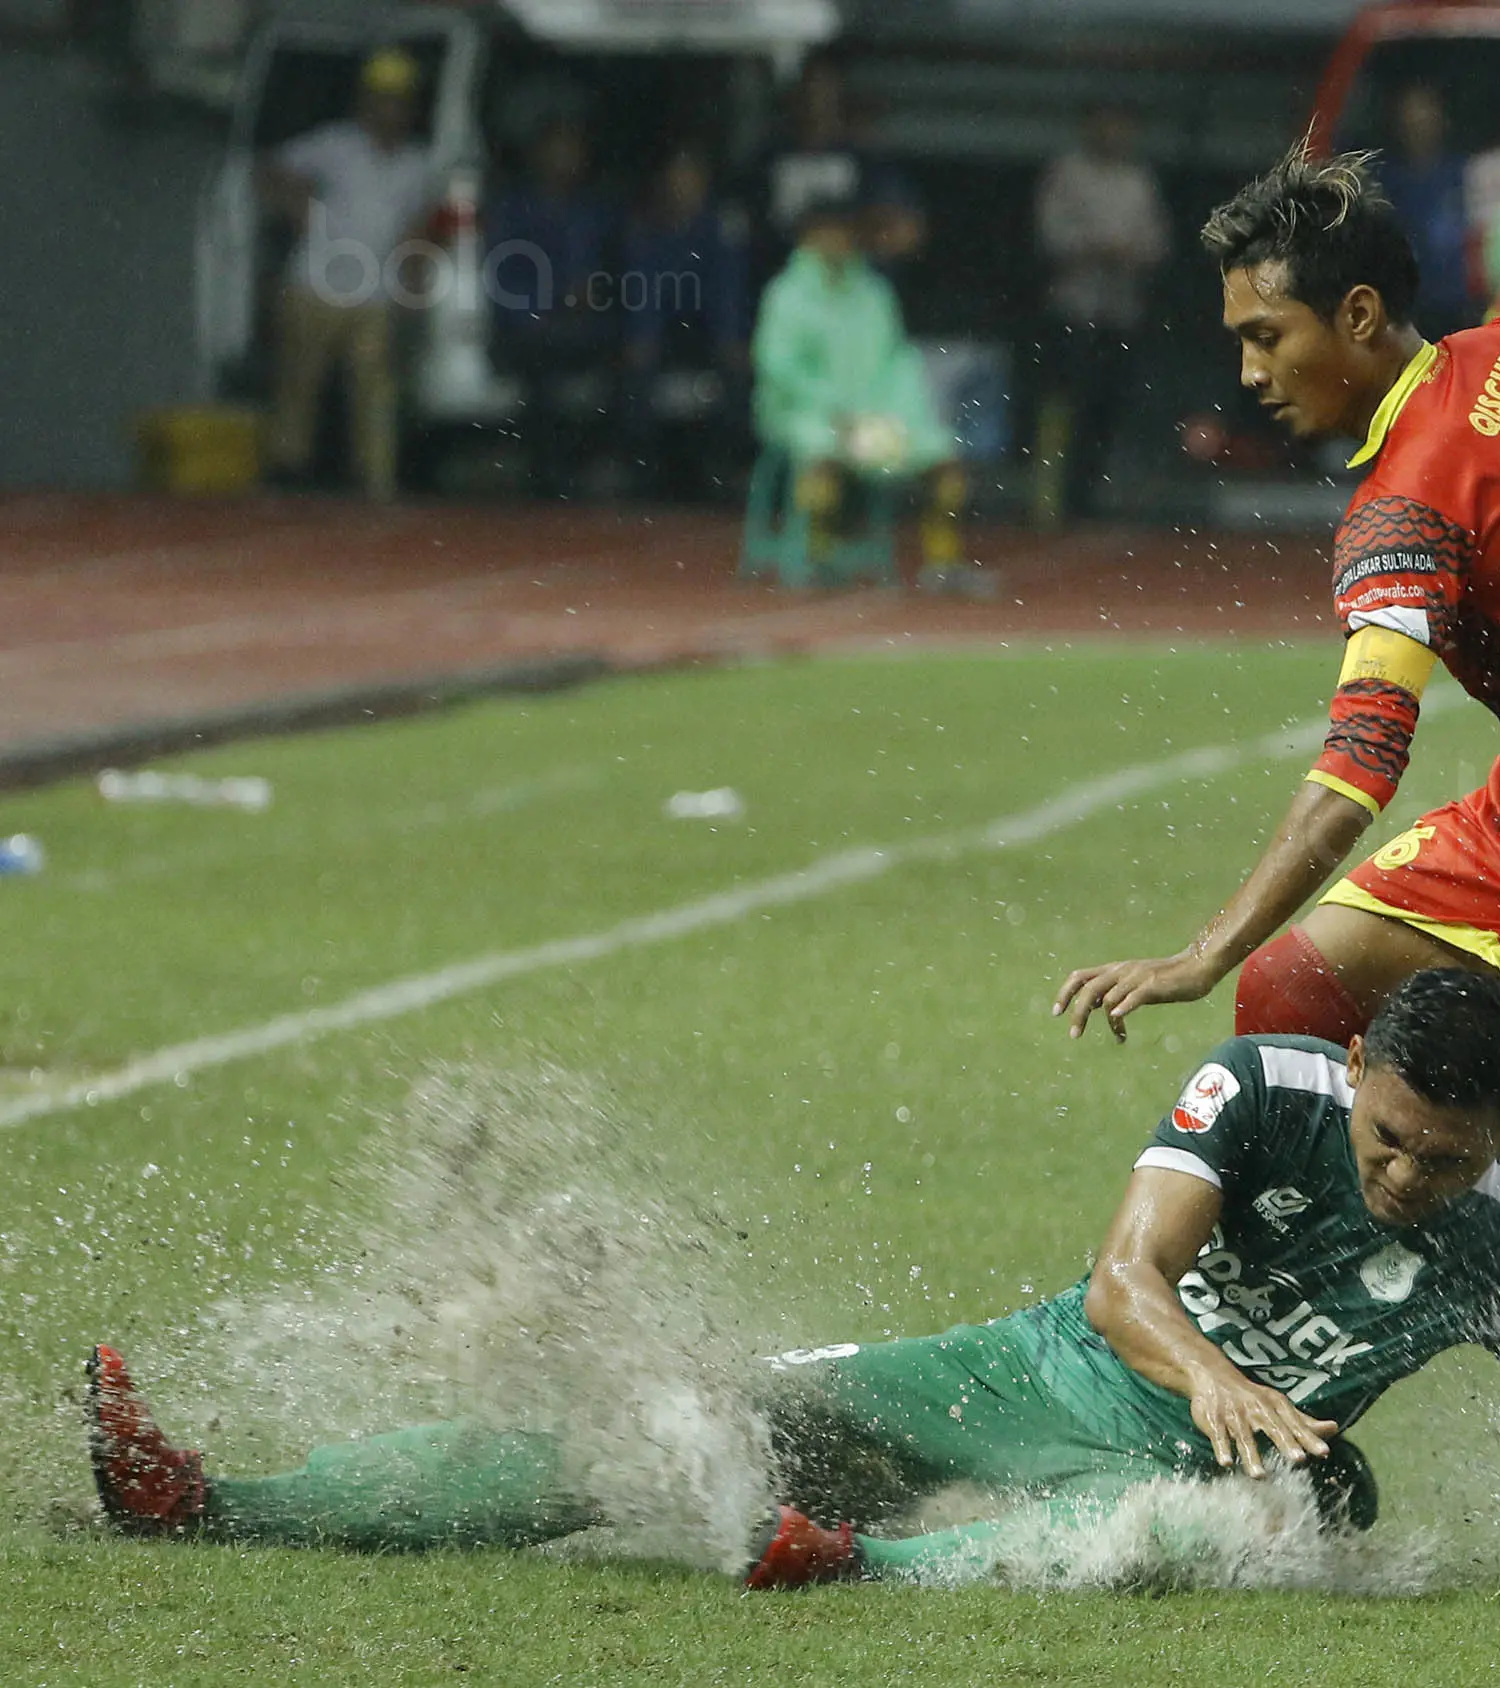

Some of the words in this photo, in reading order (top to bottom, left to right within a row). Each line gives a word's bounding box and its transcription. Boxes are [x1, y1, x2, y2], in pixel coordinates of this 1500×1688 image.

[1353, 555, 1382, 581] LASKAR
[1382, 552, 1413, 572] SULTAN
[1266, 1300, 1374, 1378] JEK
